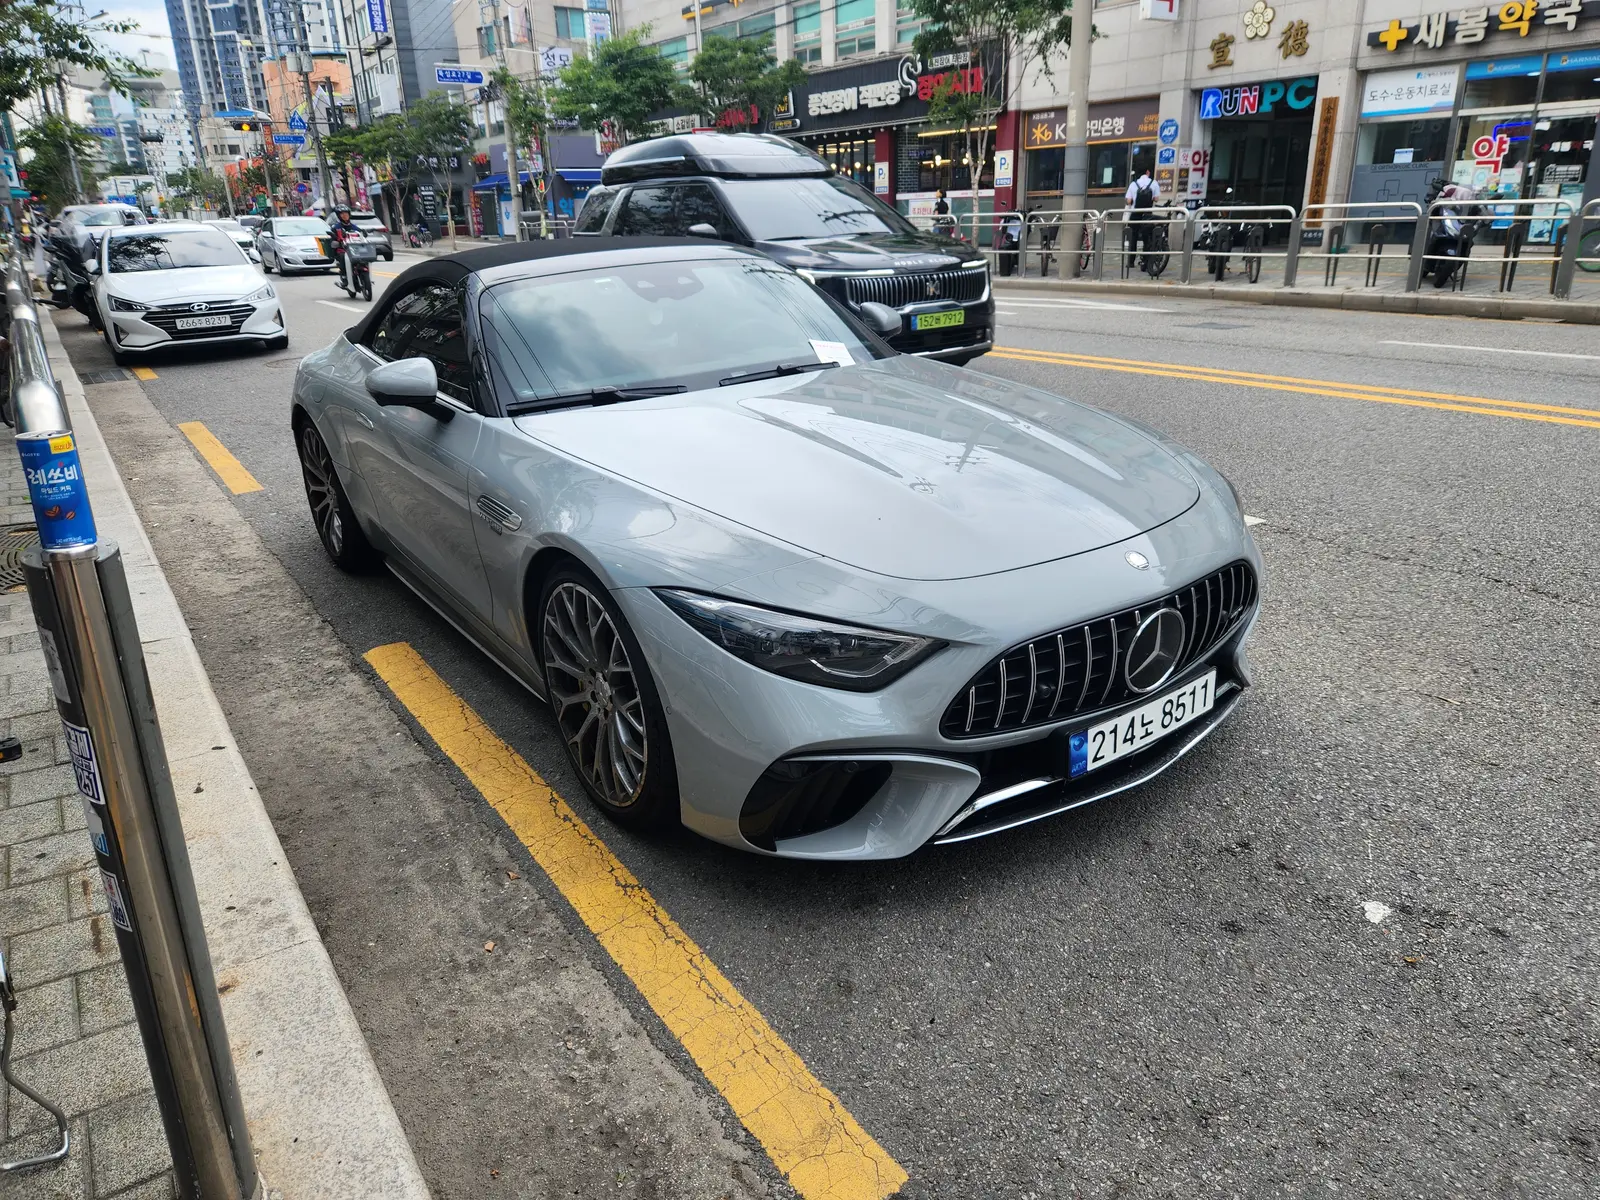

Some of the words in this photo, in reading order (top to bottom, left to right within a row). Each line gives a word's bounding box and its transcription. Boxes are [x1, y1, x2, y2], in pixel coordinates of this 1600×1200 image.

[1413, 0, 1582, 48] 새봄약국
[1207, 32, 1235, 70] 宣
[1259, 77, 1316, 112] PC
[1191, 149, 1208, 178] 약
[1472, 134, 1510, 175] 약
[204, 316, 226, 326] 8237
[943, 311, 963, 325] 7912
[27, 464, 78, 485] 레쓰비
[1092, 713, 1153, 764] 214노
[1161, 678, 1210, 729] 8511
